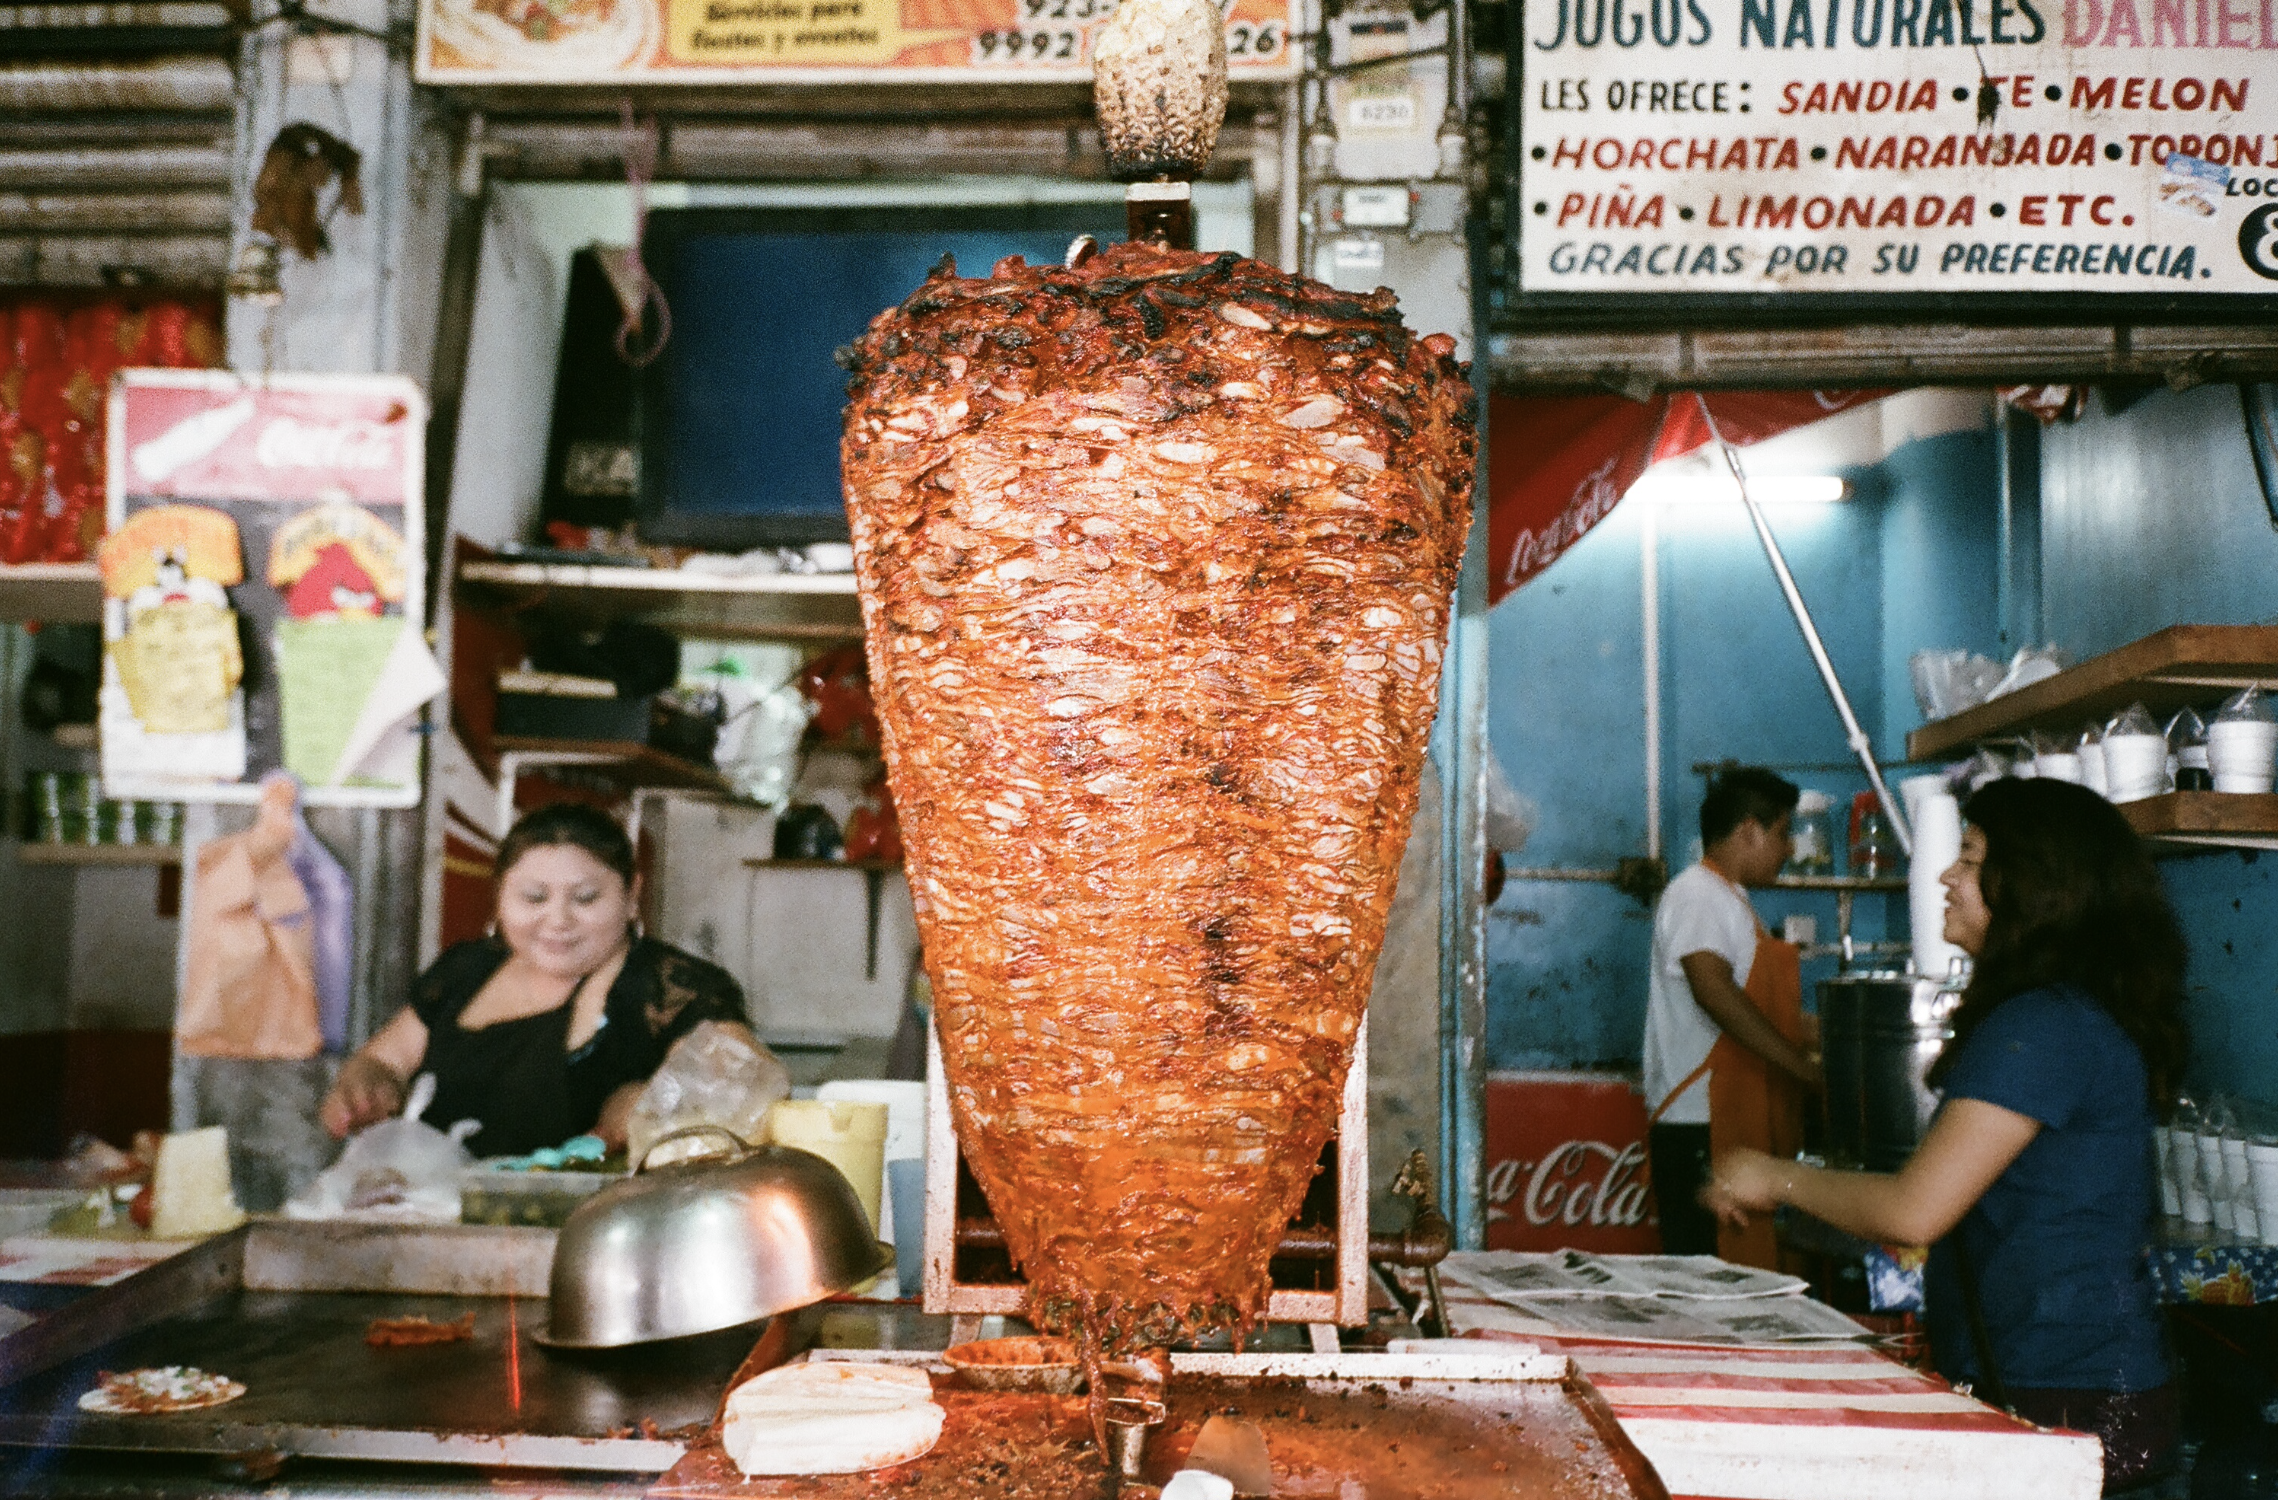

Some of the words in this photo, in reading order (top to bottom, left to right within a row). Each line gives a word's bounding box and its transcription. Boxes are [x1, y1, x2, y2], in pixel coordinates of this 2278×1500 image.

[979, 29, 1075, 58] 9992
[1534, 0, 1712, 52] JUGOS
[1740, 0, 2047, 48] NATURALES
[1540, 78, 1590, 112] LES
[1606, 80, 1751, 114] OFRECE:
[1778, 79, 1938, 116] SANDIA
[2069, 76, 2249, 112] MELON
[1552, 136, 1799, 172] HORCHATA
[1835, 133, 2096, 172] NARANJADA
[1556, 184, 1665, 229] PIÑA
[1707, 194, 1975, 231] LIMONADA
[2018, 194, 2134, 227] ETC.
[1549, 243, 1745, 277] GRACIAS
[1763, 244, 1849, 278] POR
[1872, 243, 1920, 275] SU
[1940, 243, 2212, 281] PREFERENCIA.
